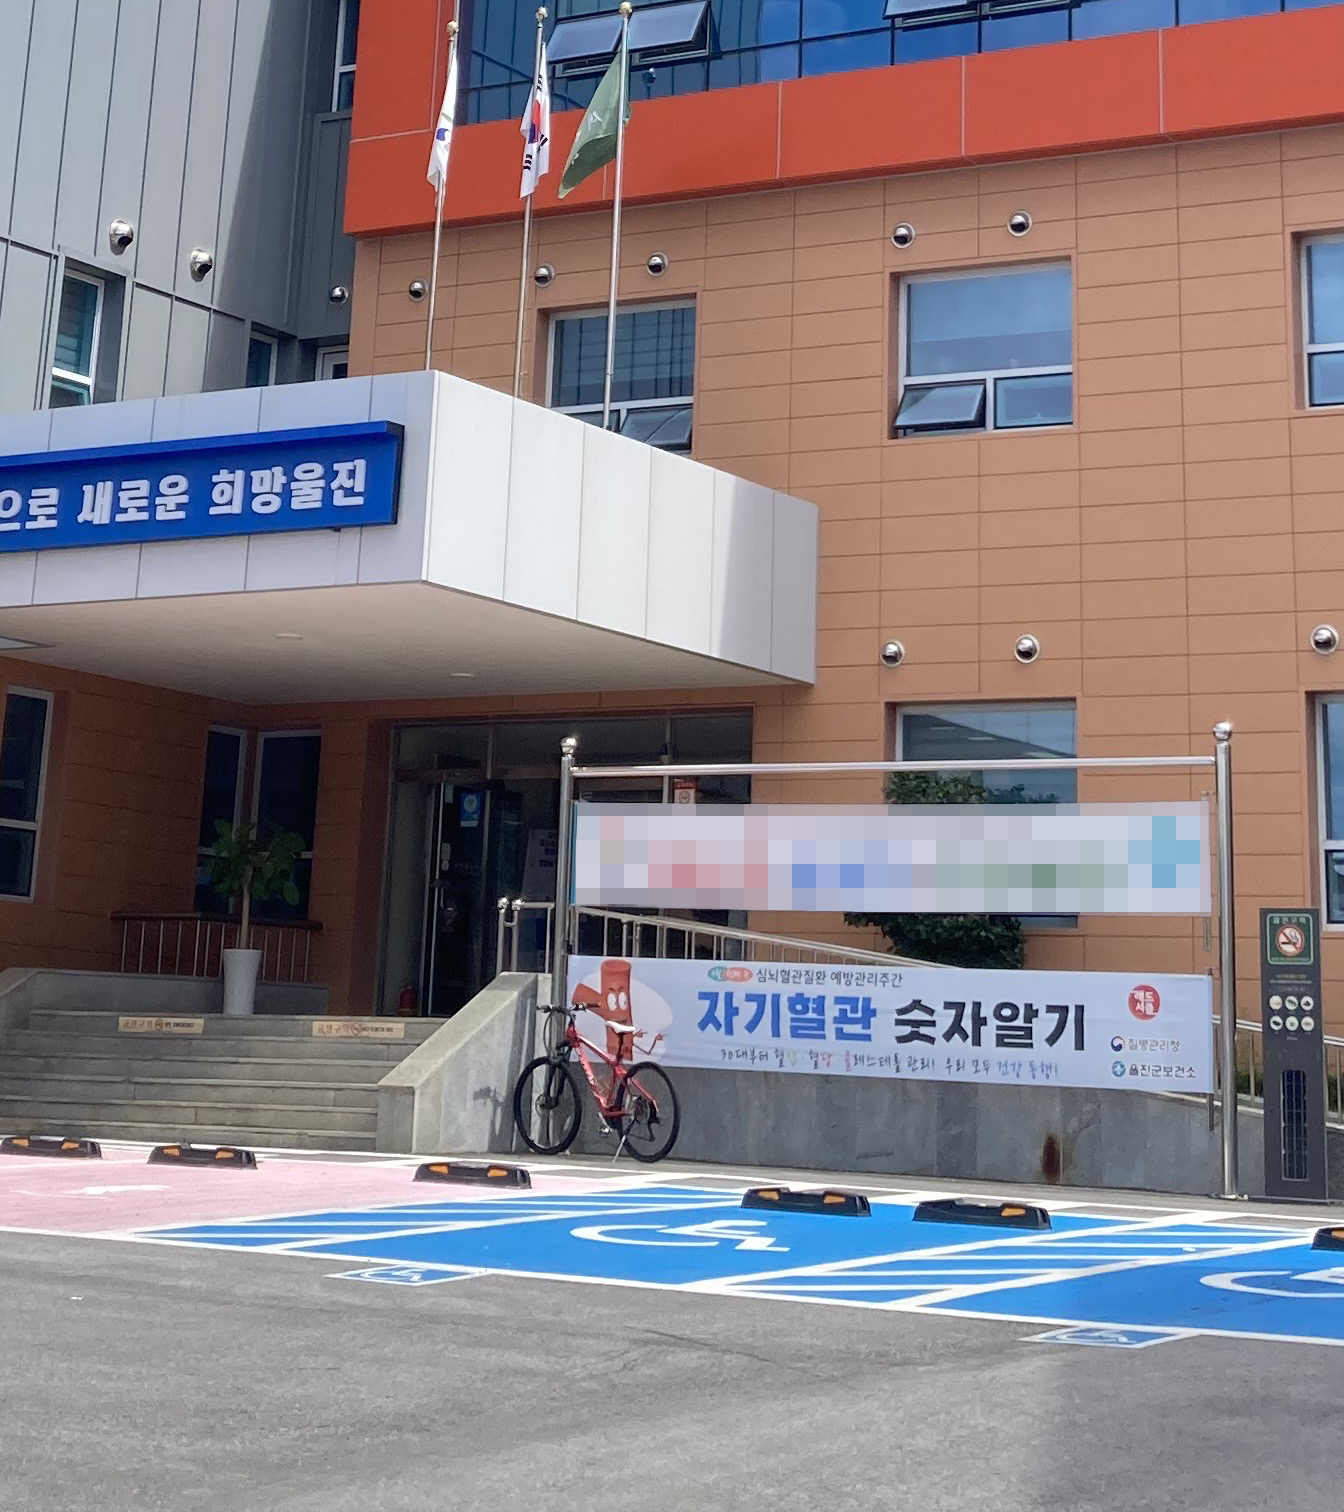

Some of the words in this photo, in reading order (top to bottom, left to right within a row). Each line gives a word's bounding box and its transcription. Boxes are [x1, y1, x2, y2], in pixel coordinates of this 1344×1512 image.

[77, 474, 190, 526] 새로운
[208, 459, 366, 516] 희망울진
[756, 967, 826, 986] 심뇌혈관질환
[830, 972, 903, 988] 예방관리주간
[697, 991, 877, 1042] 자기혈관
[894, 999, 1085, 1051] 숫자알기
[1128, 1038, 1179, 1052] 질병관리청
[720, 1048, 769, 1066] 30대부터
[945, 1057, 965, 1075] 우리
[1129, 1064, 1196, 1078] 울진군보건소
